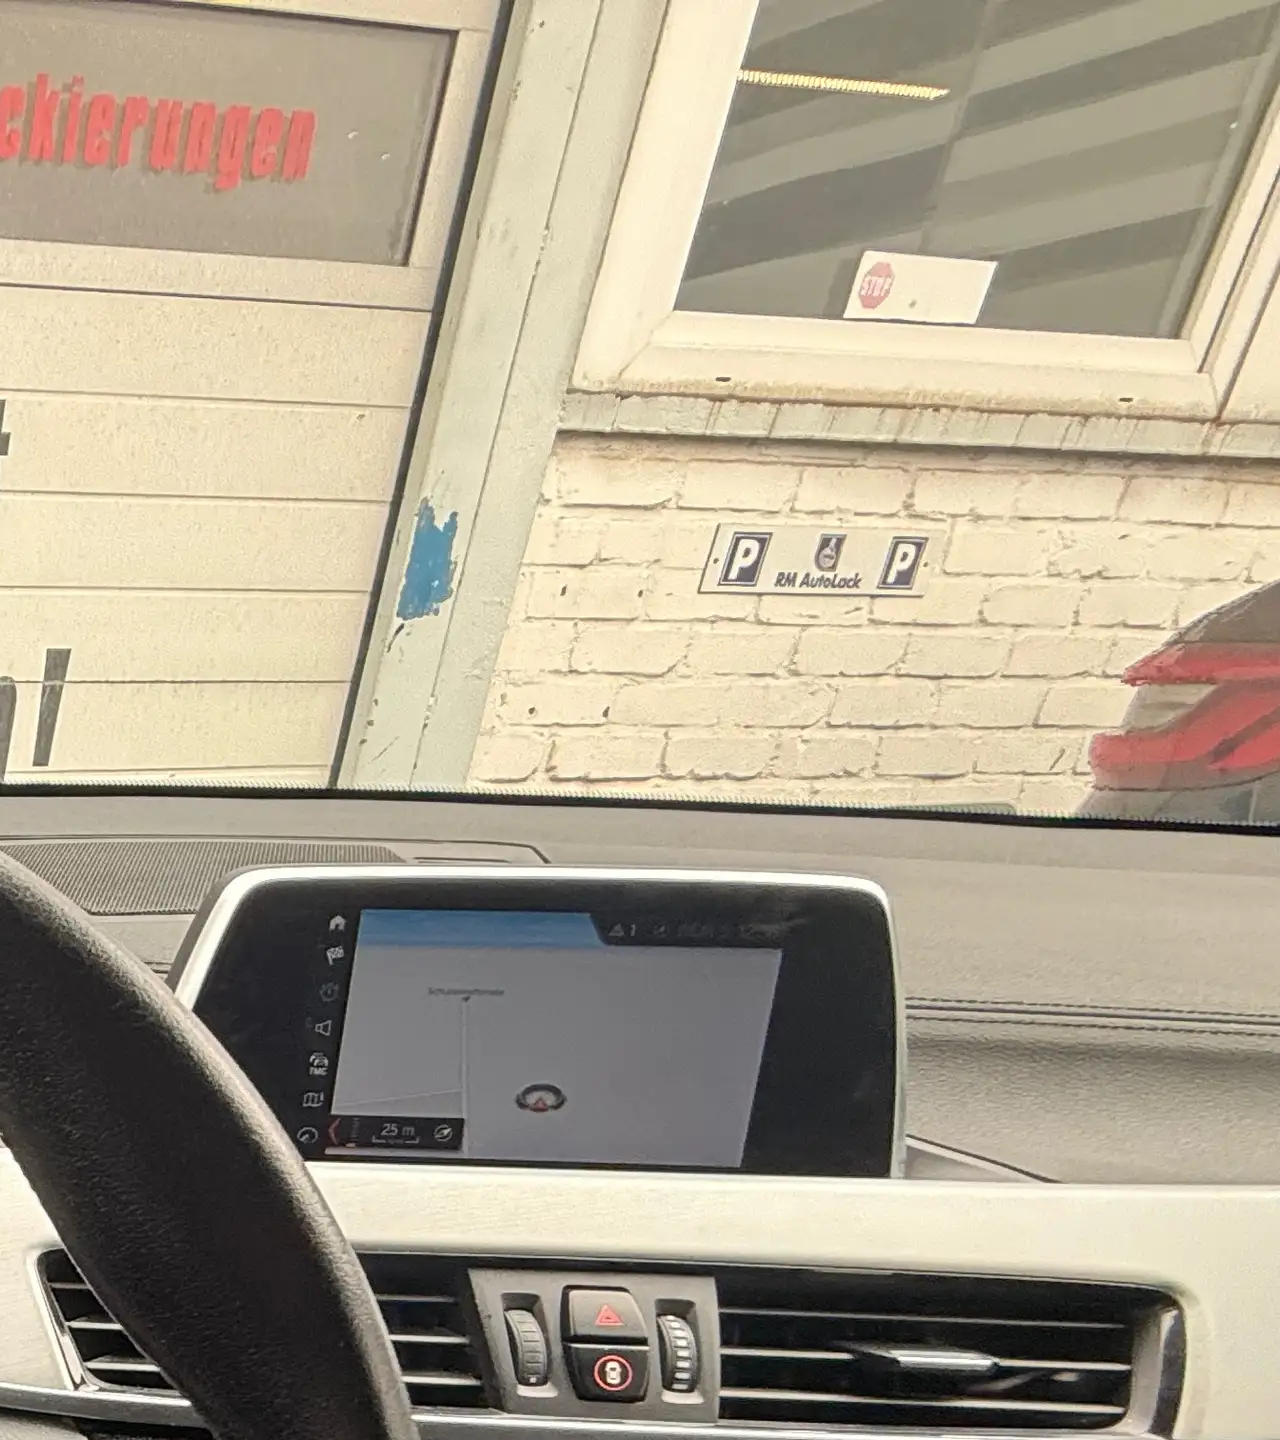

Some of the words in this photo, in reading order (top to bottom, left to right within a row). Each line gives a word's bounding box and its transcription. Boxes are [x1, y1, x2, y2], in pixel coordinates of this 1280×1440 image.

[728, 537, 760, 581] P
[774, 571, 797, 588] RM
[799, 572, 863, 589] AutoLack
[885, 543, 917, 585] P
[380, 1122, 398, 1136] 25
[401, 1125, 415, 1136] m
